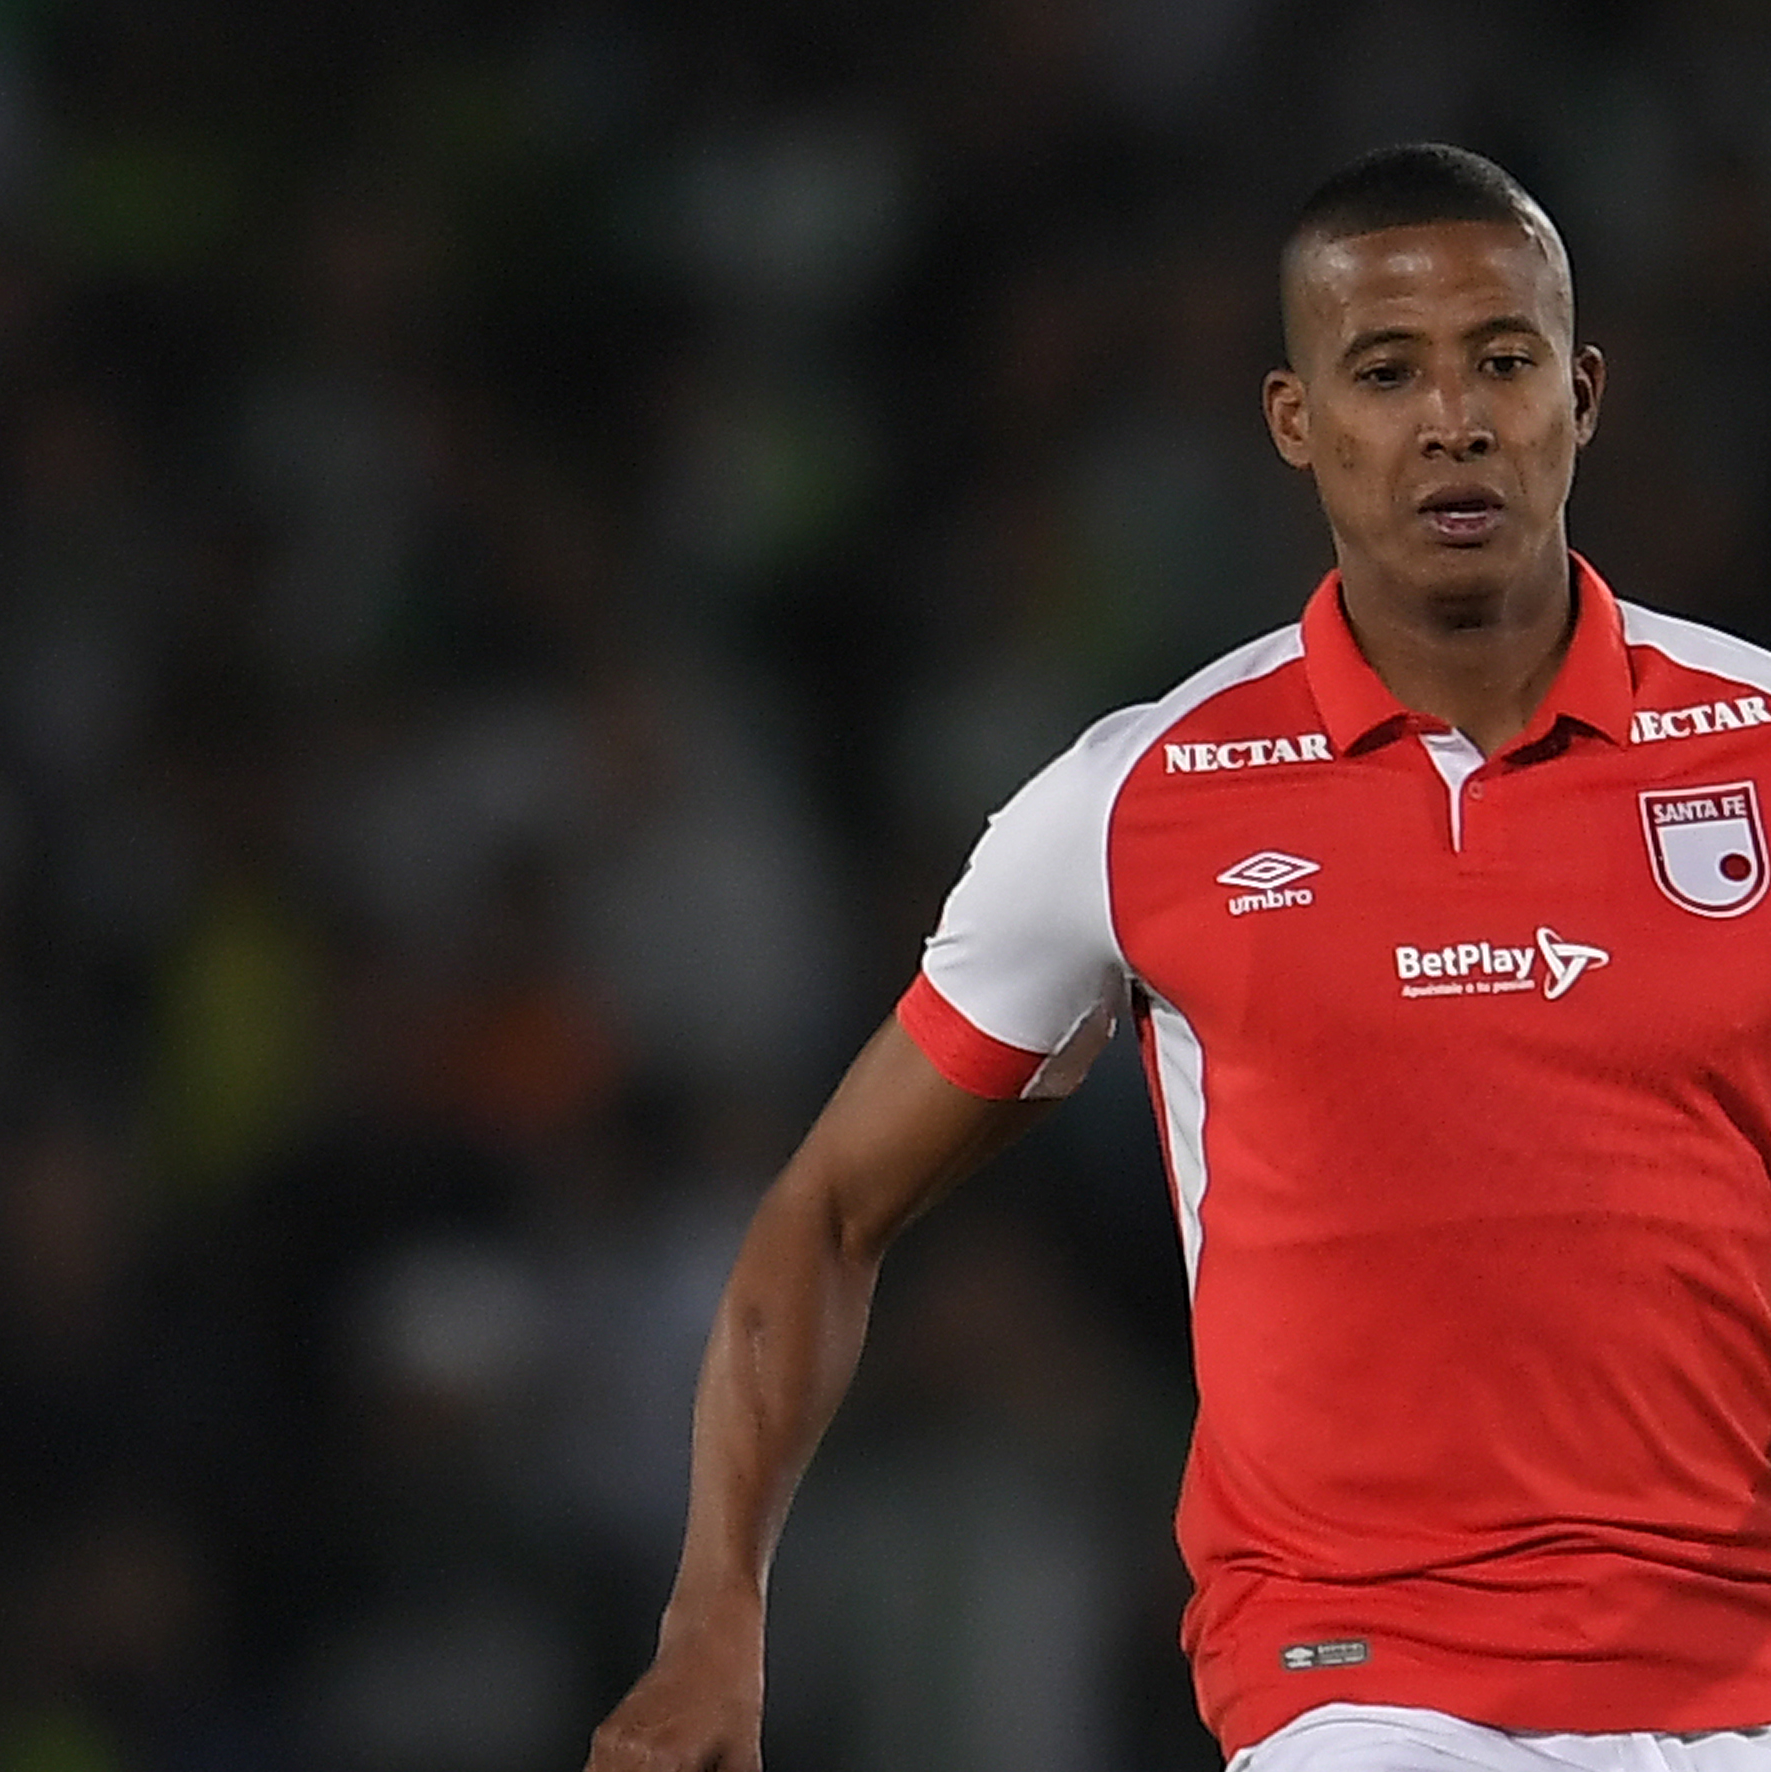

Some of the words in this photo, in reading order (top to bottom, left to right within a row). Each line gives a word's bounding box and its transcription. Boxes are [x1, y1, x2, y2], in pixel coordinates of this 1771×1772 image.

[1164, 734, 1333, 774] NECTAR
[1652, 799, 1718, 825] SANTA
[1721, 794, 1748, 818] FE
[1229, 888, 1313, 916] umbro
[1395, 941, 1535, 980] BetPlay
